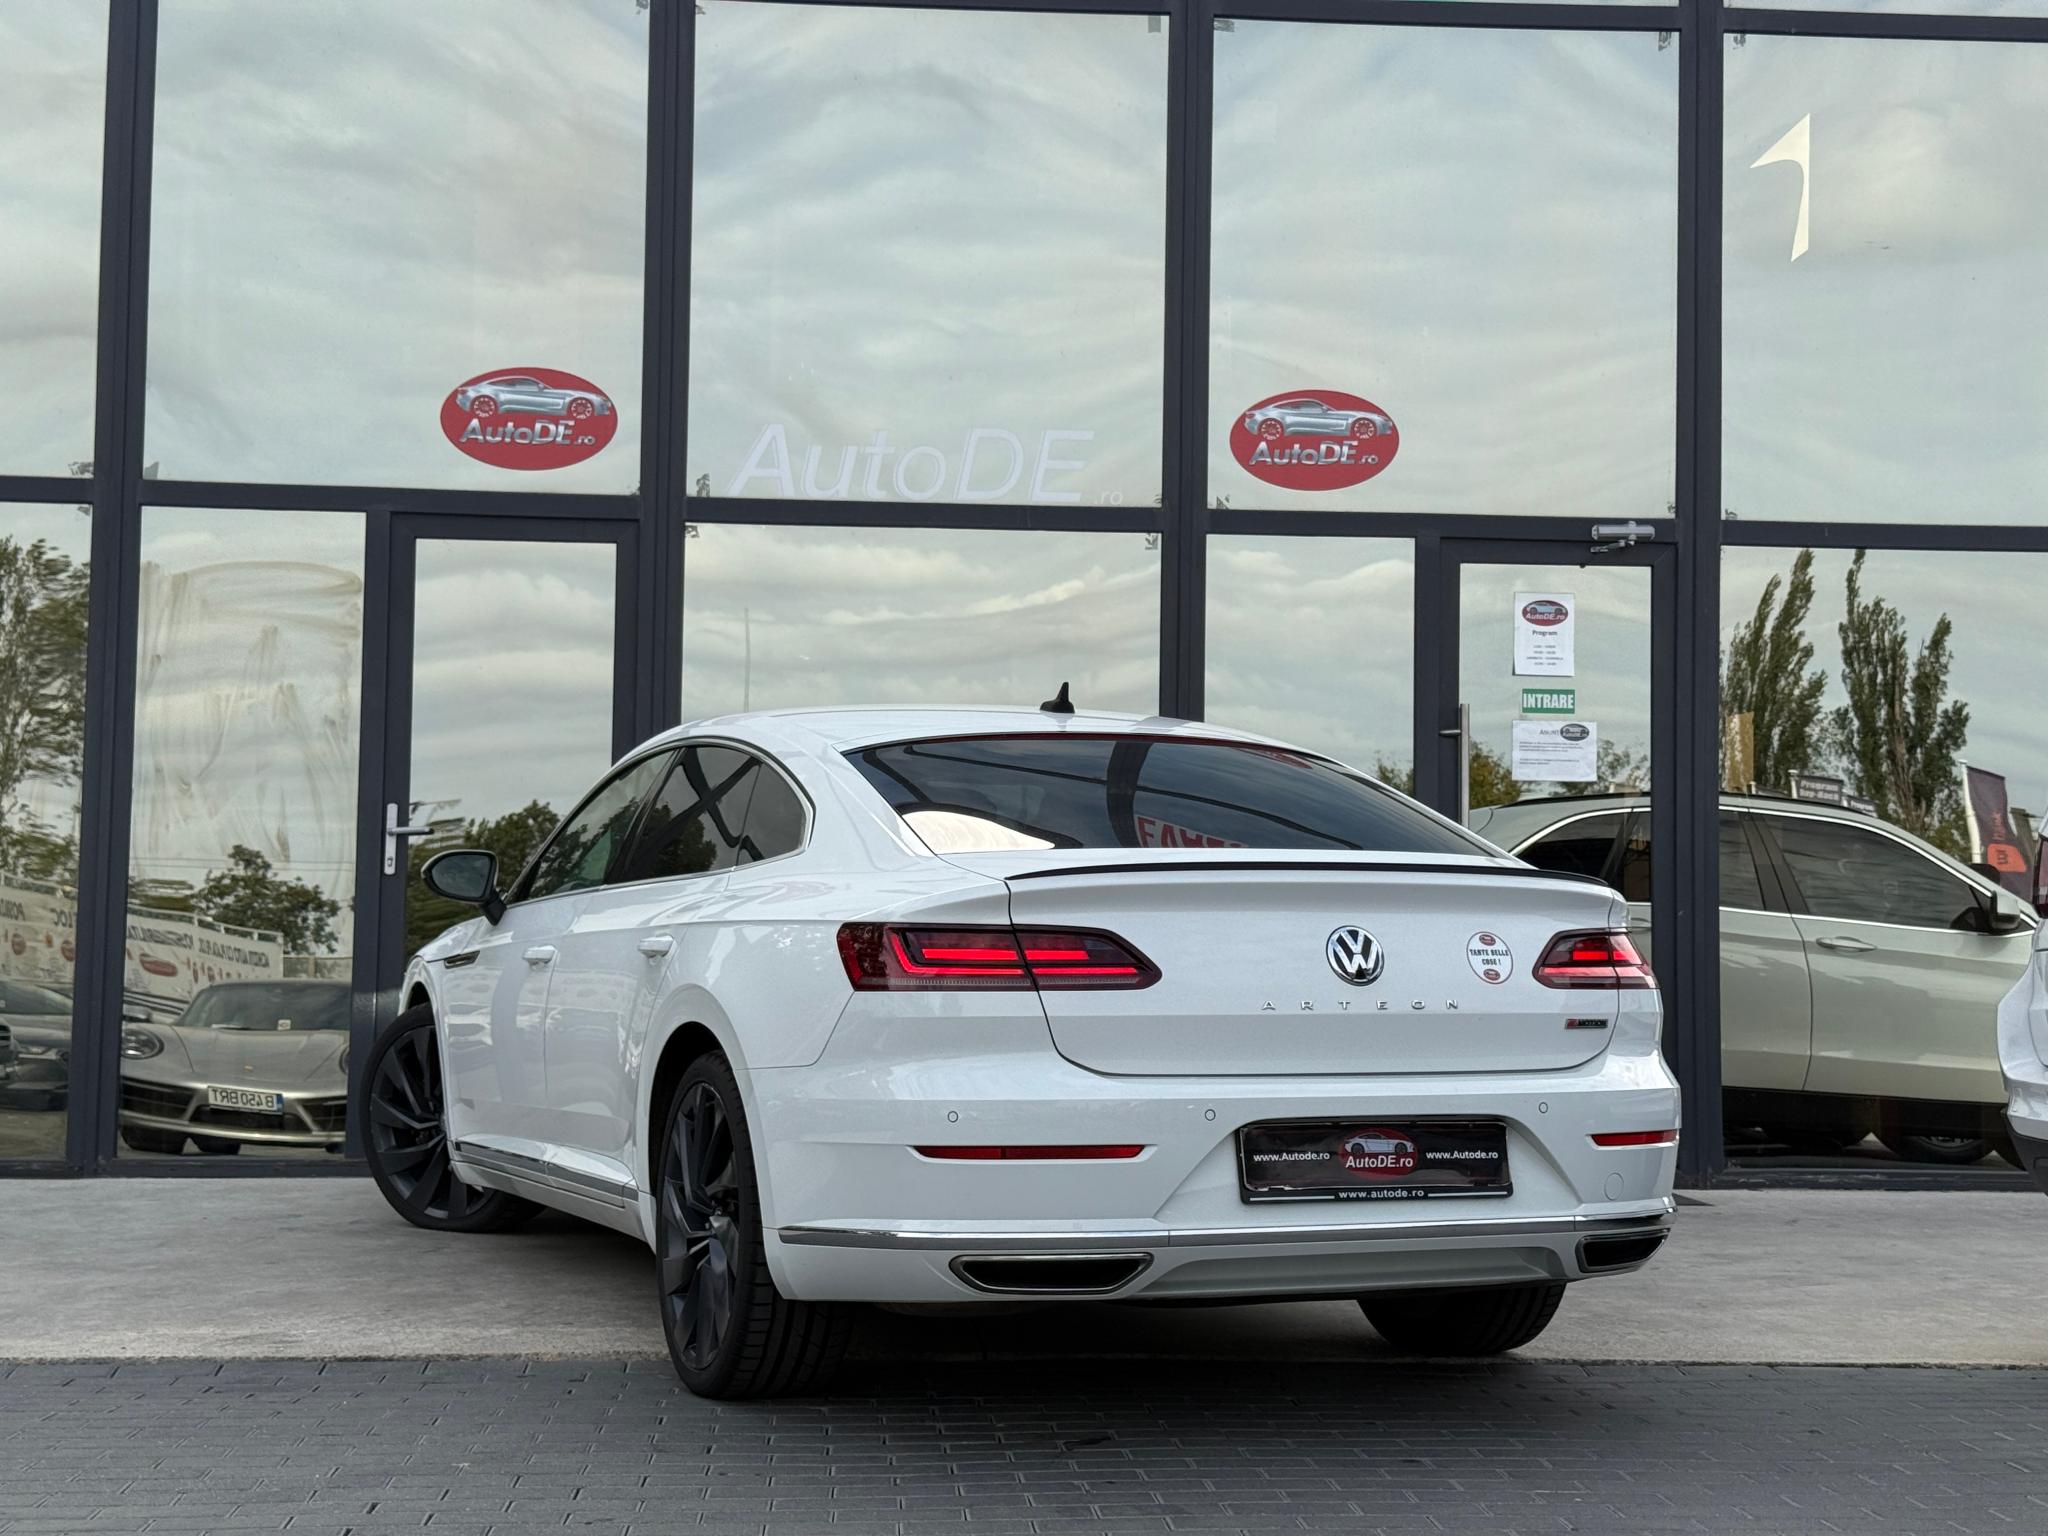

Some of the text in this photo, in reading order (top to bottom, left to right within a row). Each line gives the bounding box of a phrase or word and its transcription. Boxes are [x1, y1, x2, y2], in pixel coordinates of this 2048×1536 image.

[1523, 693, 1574, 709] INTRARE
[1261, 999, 1458, 1011] ARTEON
[1253, 1151, 1331, 1162] www.Autode.ro
[1425, 1150, 1499, 1160] www.Autode.ro
[1345, 1155, 1414, 1169] AutoDE.ro
[1338, 1188, 1425, 1199] www.autode.ro
